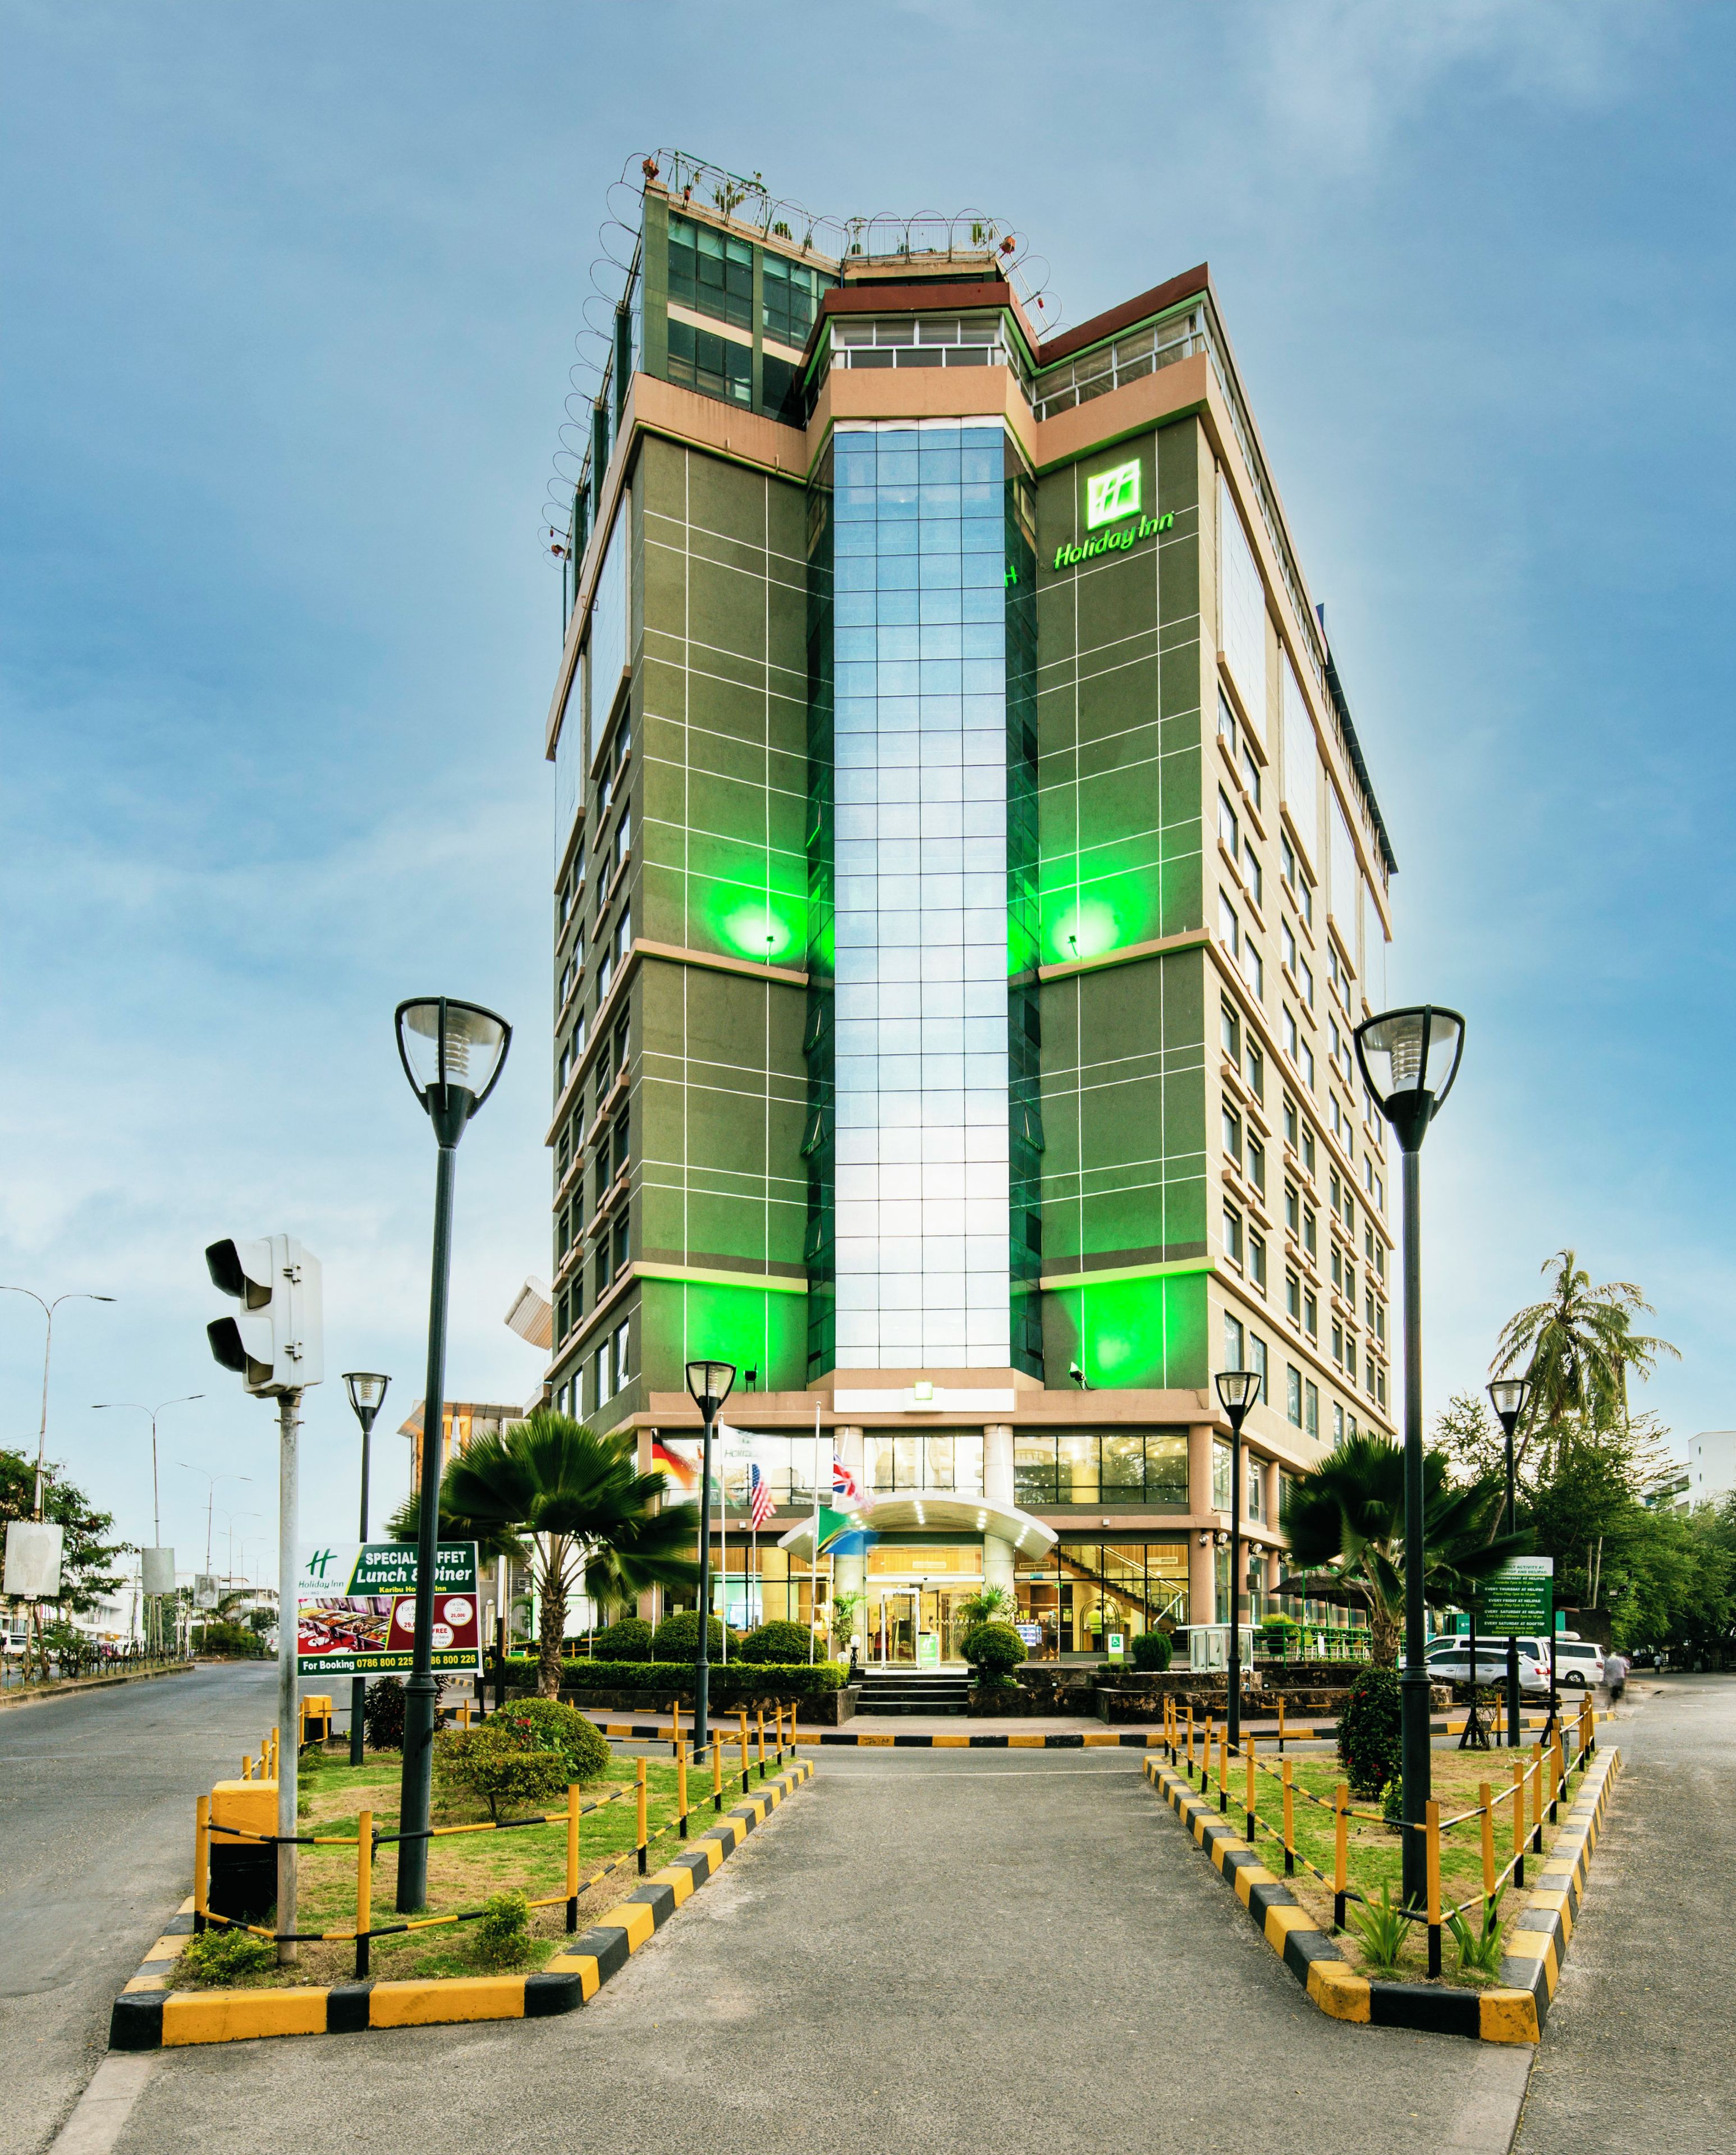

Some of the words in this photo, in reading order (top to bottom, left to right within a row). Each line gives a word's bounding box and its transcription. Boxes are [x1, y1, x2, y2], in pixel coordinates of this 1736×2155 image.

[1054, 529, 1136, 571] Holiday
[1138, 515, 1174, 540] Inn
[365, 1552, 417, 1565] SPECIAL
[437, 1551, 466, 1564] FFET
[356, 1567, 407, 1583] Lunch
[299, 1580, 329, 1589] Holiday
[303, 1660, 317, 1671] For
[319, 1659, 355, 1671] Booking
[356, 1658, 378, 1668] 0786
[380, 1657, 395, 1667] 800
[398, 1657, 413, 1666] 225
[430, 1656, 440, 1665] 86
[443, 1655, 458, 1665] 800
[460, 1655, 476, 1664] 226
